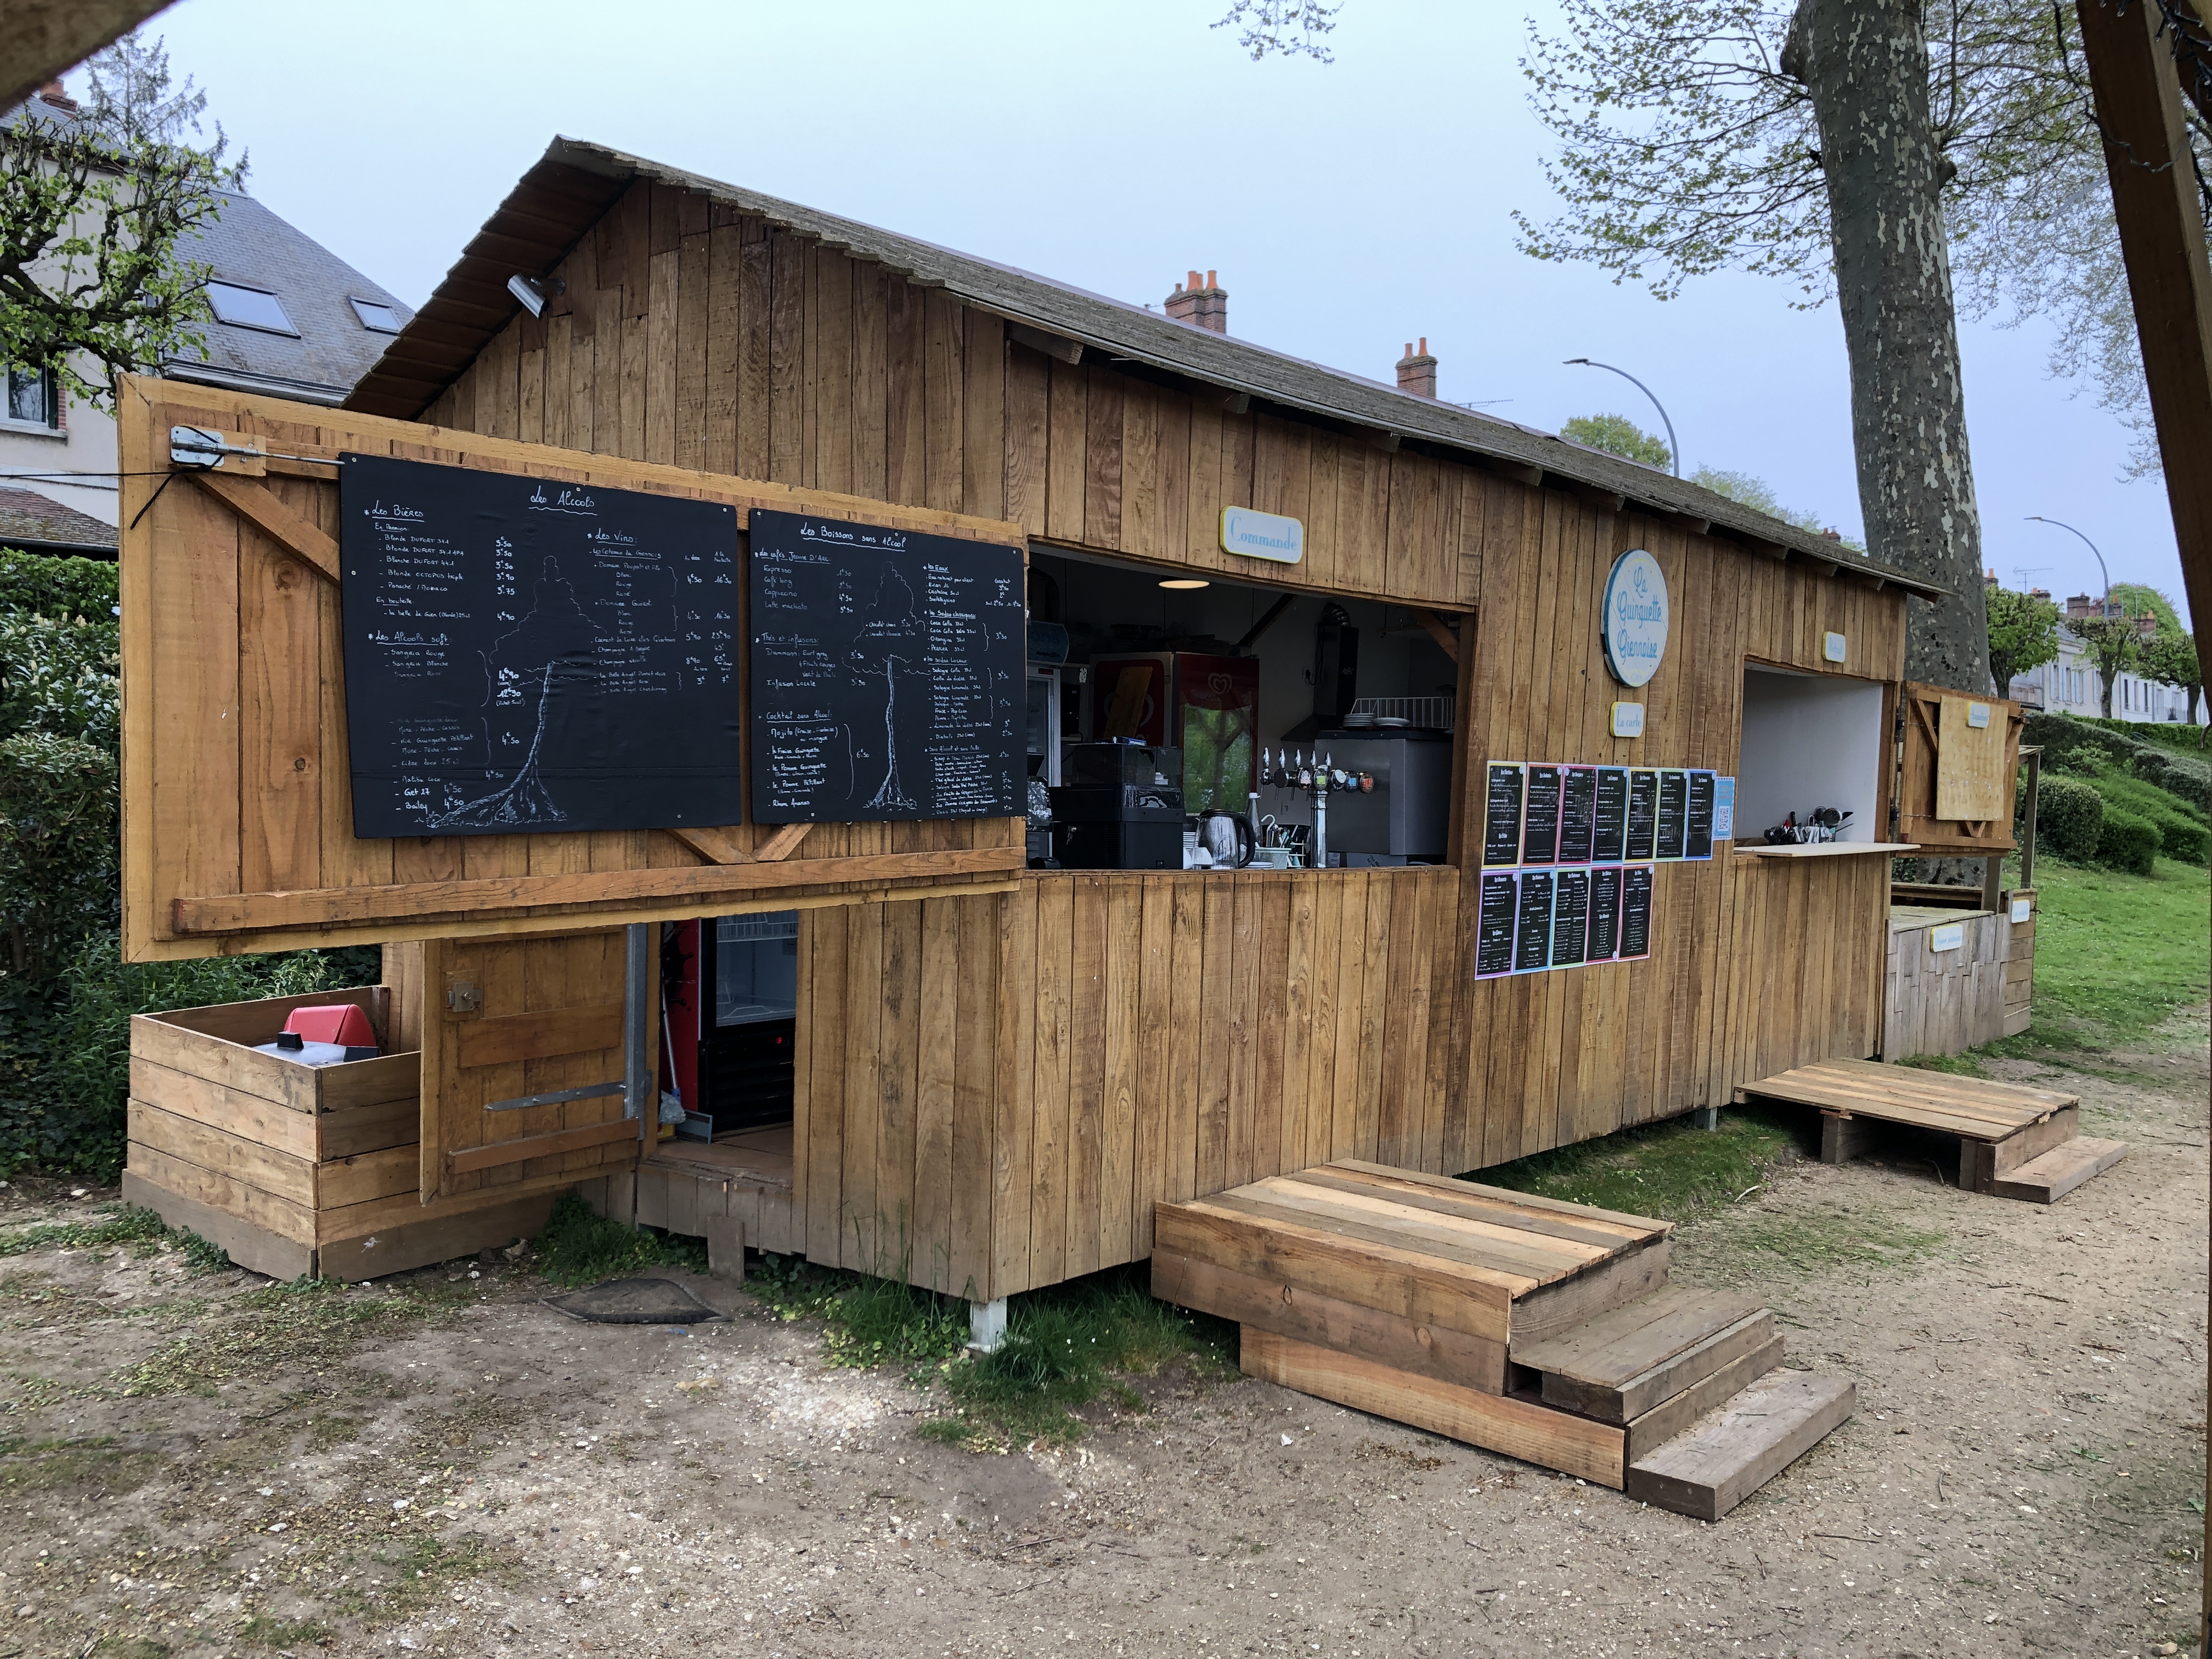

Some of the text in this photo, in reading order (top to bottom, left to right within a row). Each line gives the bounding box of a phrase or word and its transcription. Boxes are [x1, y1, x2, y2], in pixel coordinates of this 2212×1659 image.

[531, 485, 595, 507] Les Alcools
[372, 500, 424, 517] Les Bières
[375, 522, 382, 531] En
[1231, 516, 1297, 550] Commande
[595, 528, 610, 540] Les
[800, 522, 906, 548] Les Boissons sans Alcool
[763, 565, 792, 574] Expresso
[764, 575, 792, 589] Café long
[1634, 566, 1647, 599] La
[764, 589, 797, 599] Cappuccino
[1617, 590, 1662, 629] Guinguette
[376, 630, 388, 641] Les
[394, 631, 424, 642] Alcools
[761, 632, 775, 641] Thés
[391, 649, 420, 659] Sangria
[1617, 629, 1657, 666] Giennoise
[766, 711, 793, 719] Cocktail
[1617, 709, 1641, 727] La carte
